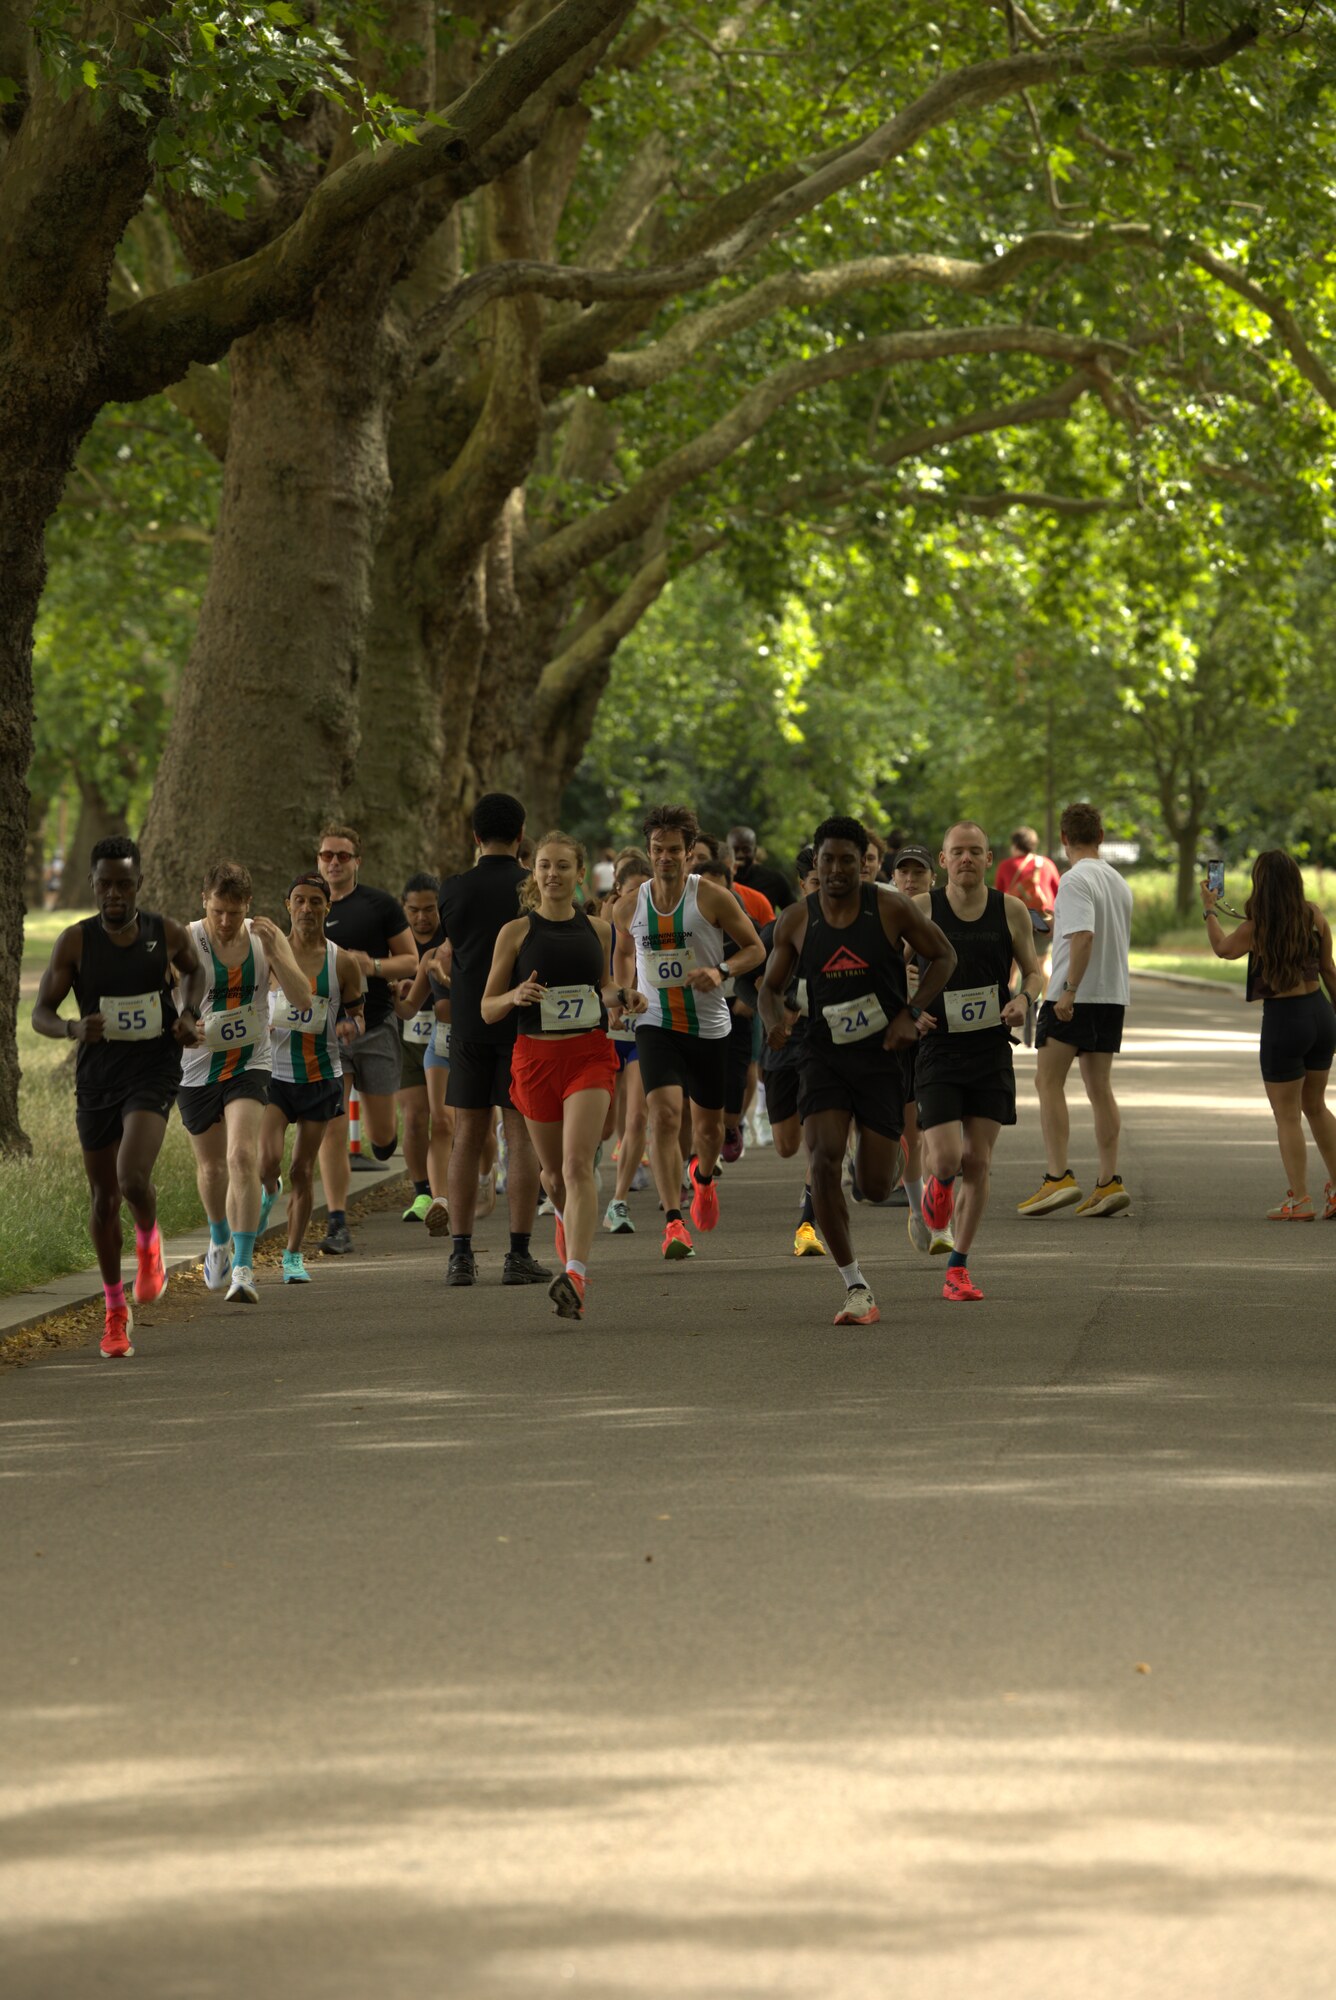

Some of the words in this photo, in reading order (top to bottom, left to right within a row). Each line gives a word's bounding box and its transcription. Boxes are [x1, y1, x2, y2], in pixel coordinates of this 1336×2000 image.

[199, 937, 210, 954] soar
[658, 961, 683, 979] 60
[845, 967, 866, 977] TRAIL
[287, 1004, 313, 1023] 30
[557, 998, 584, 1019] 27
[961, 1000, 987, 1022] 67
[118, 1009, 147, 1030] 55
[412, 1021, 432, 1036] 42
[841, 1009, 870, 1033] 24
[220, 1019, 247, 1041] 65
